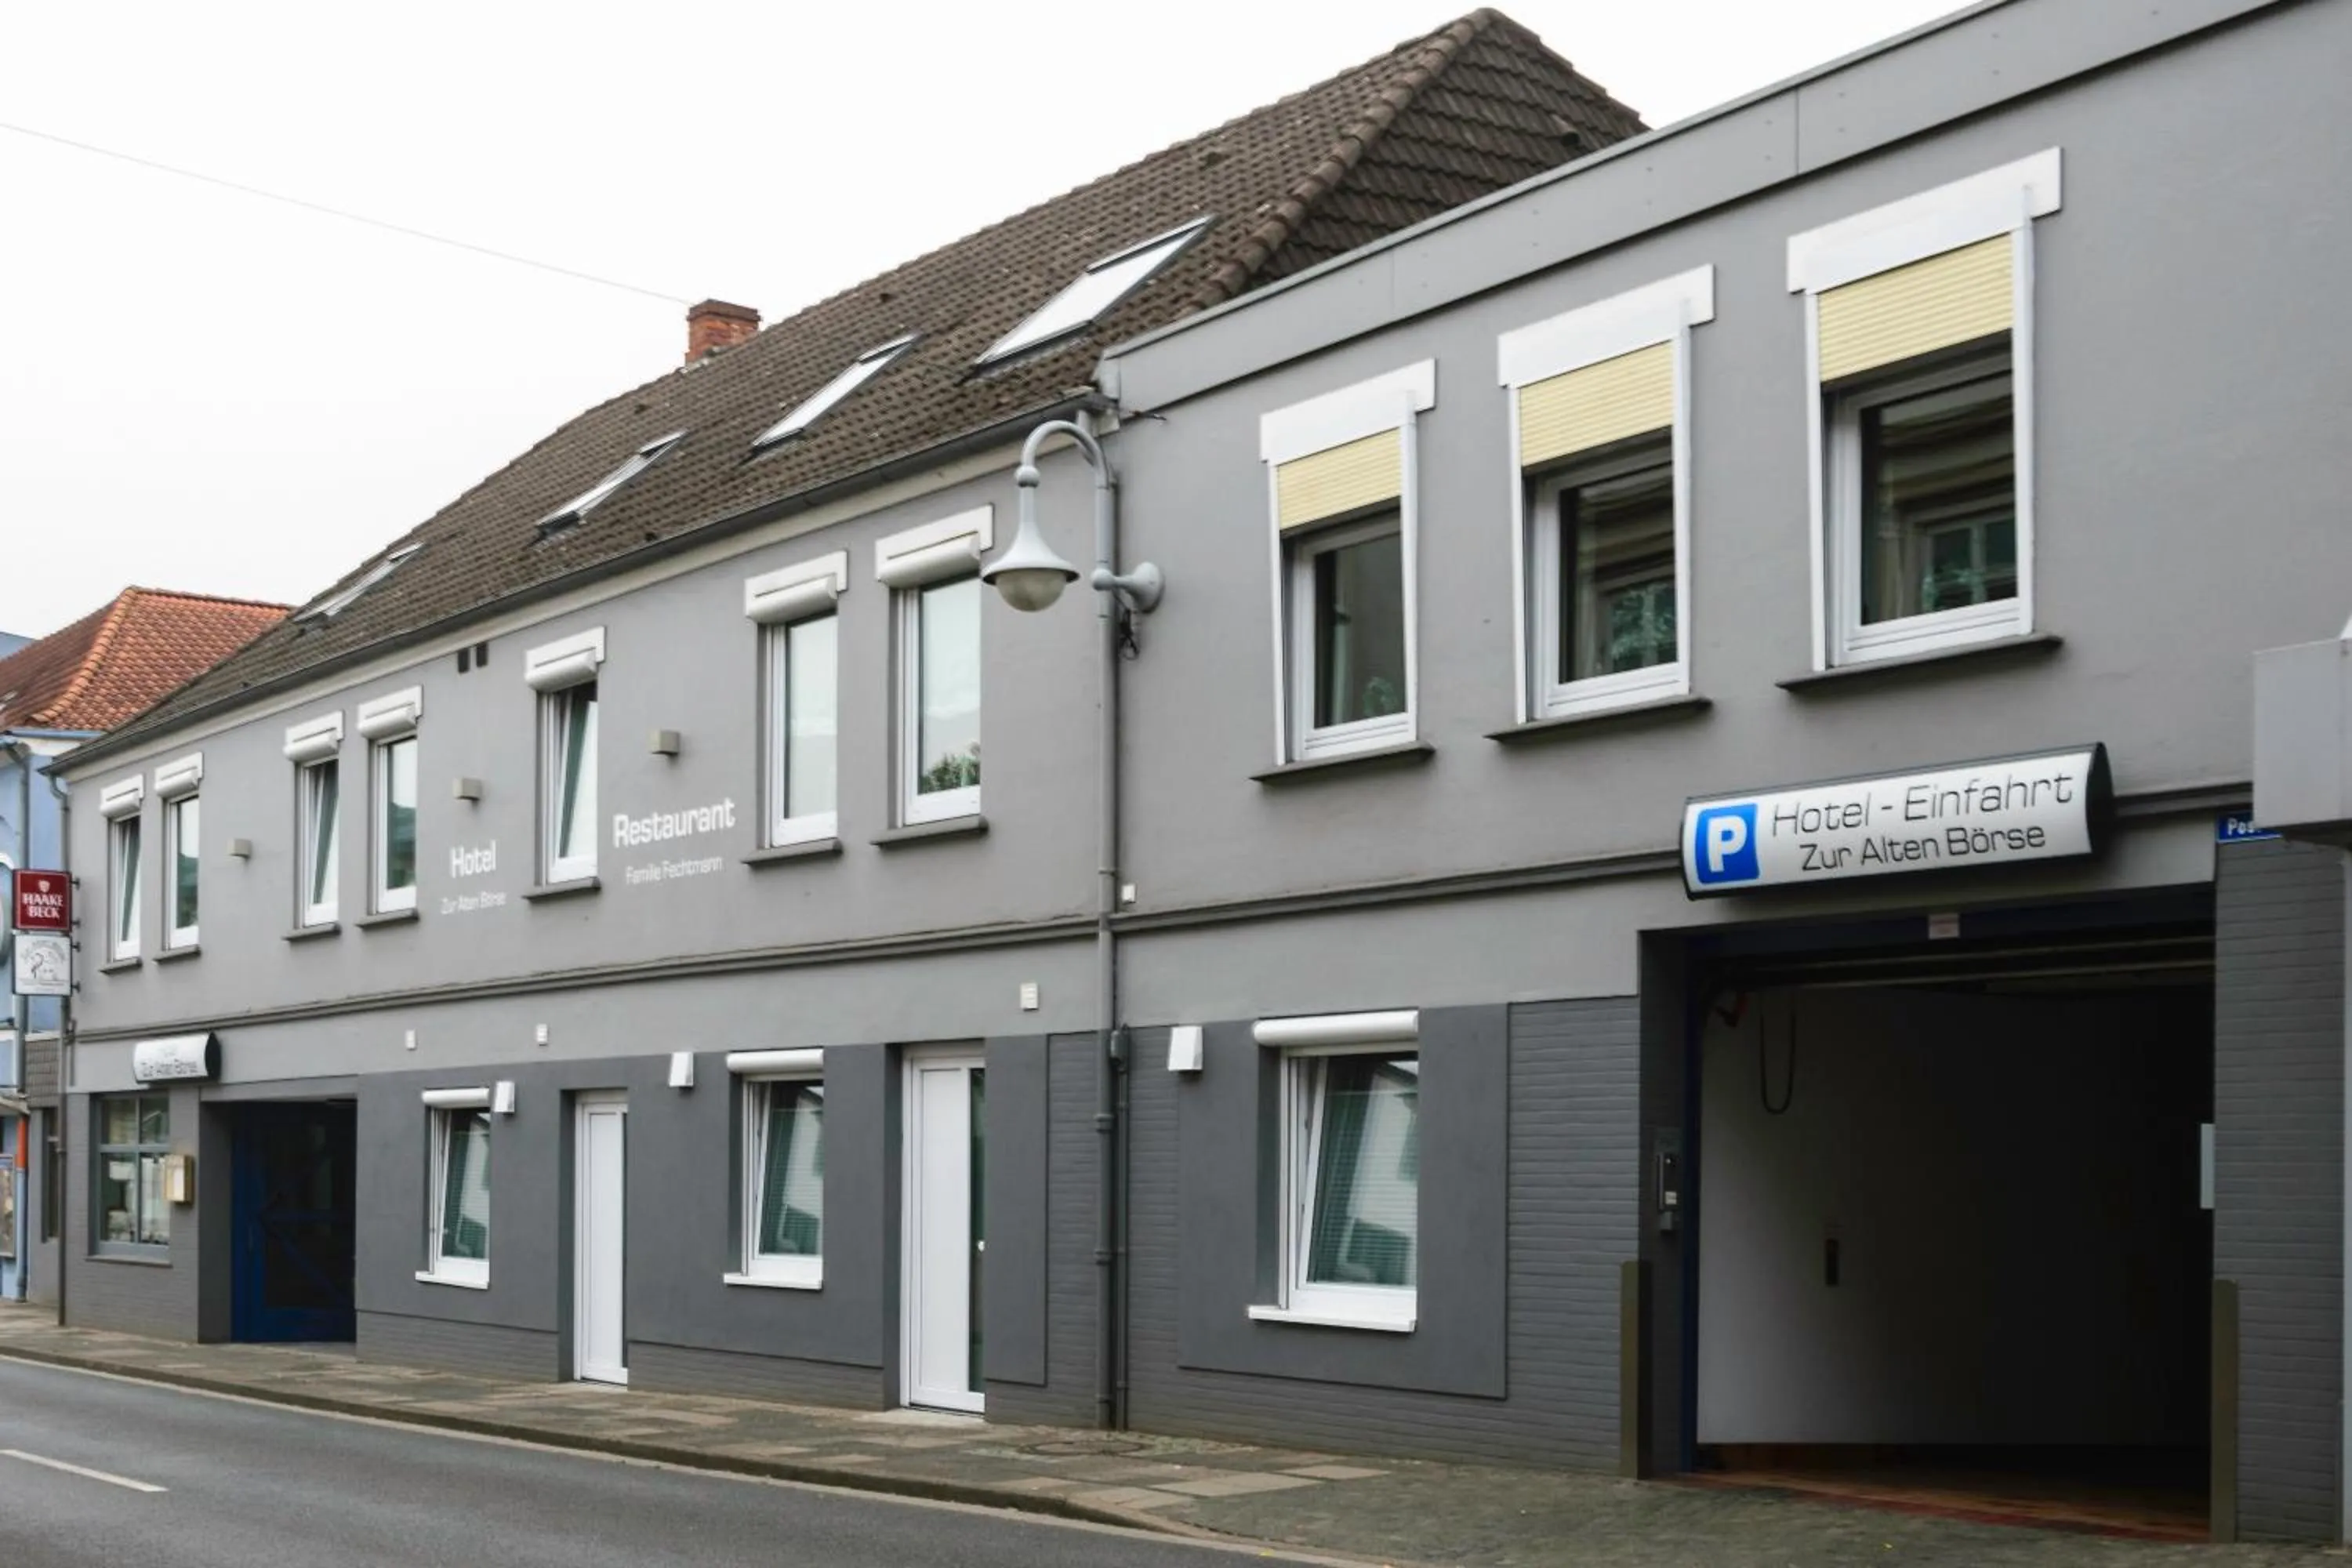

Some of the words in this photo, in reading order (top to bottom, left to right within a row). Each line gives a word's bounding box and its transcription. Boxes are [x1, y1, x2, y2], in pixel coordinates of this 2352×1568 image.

[613, 797, 735, 848] Restaurant
[1773, 791, 1871, 837] Hotel
[1905, 772, 2073, 822] Einfahrt
[1707, 815, 1748, 873] P
[2227, 817, 2262, 837] Pos
[450, 838, 496, 878] Hotel
[1799, 843, 1853, 872] Zur
[1861, 834, 1940, 866] Alten
[1946, 826, 2046, 856] Börse
[22, 892, 64, 907] HAAKE
[27, 906, 60, 919] BECK
